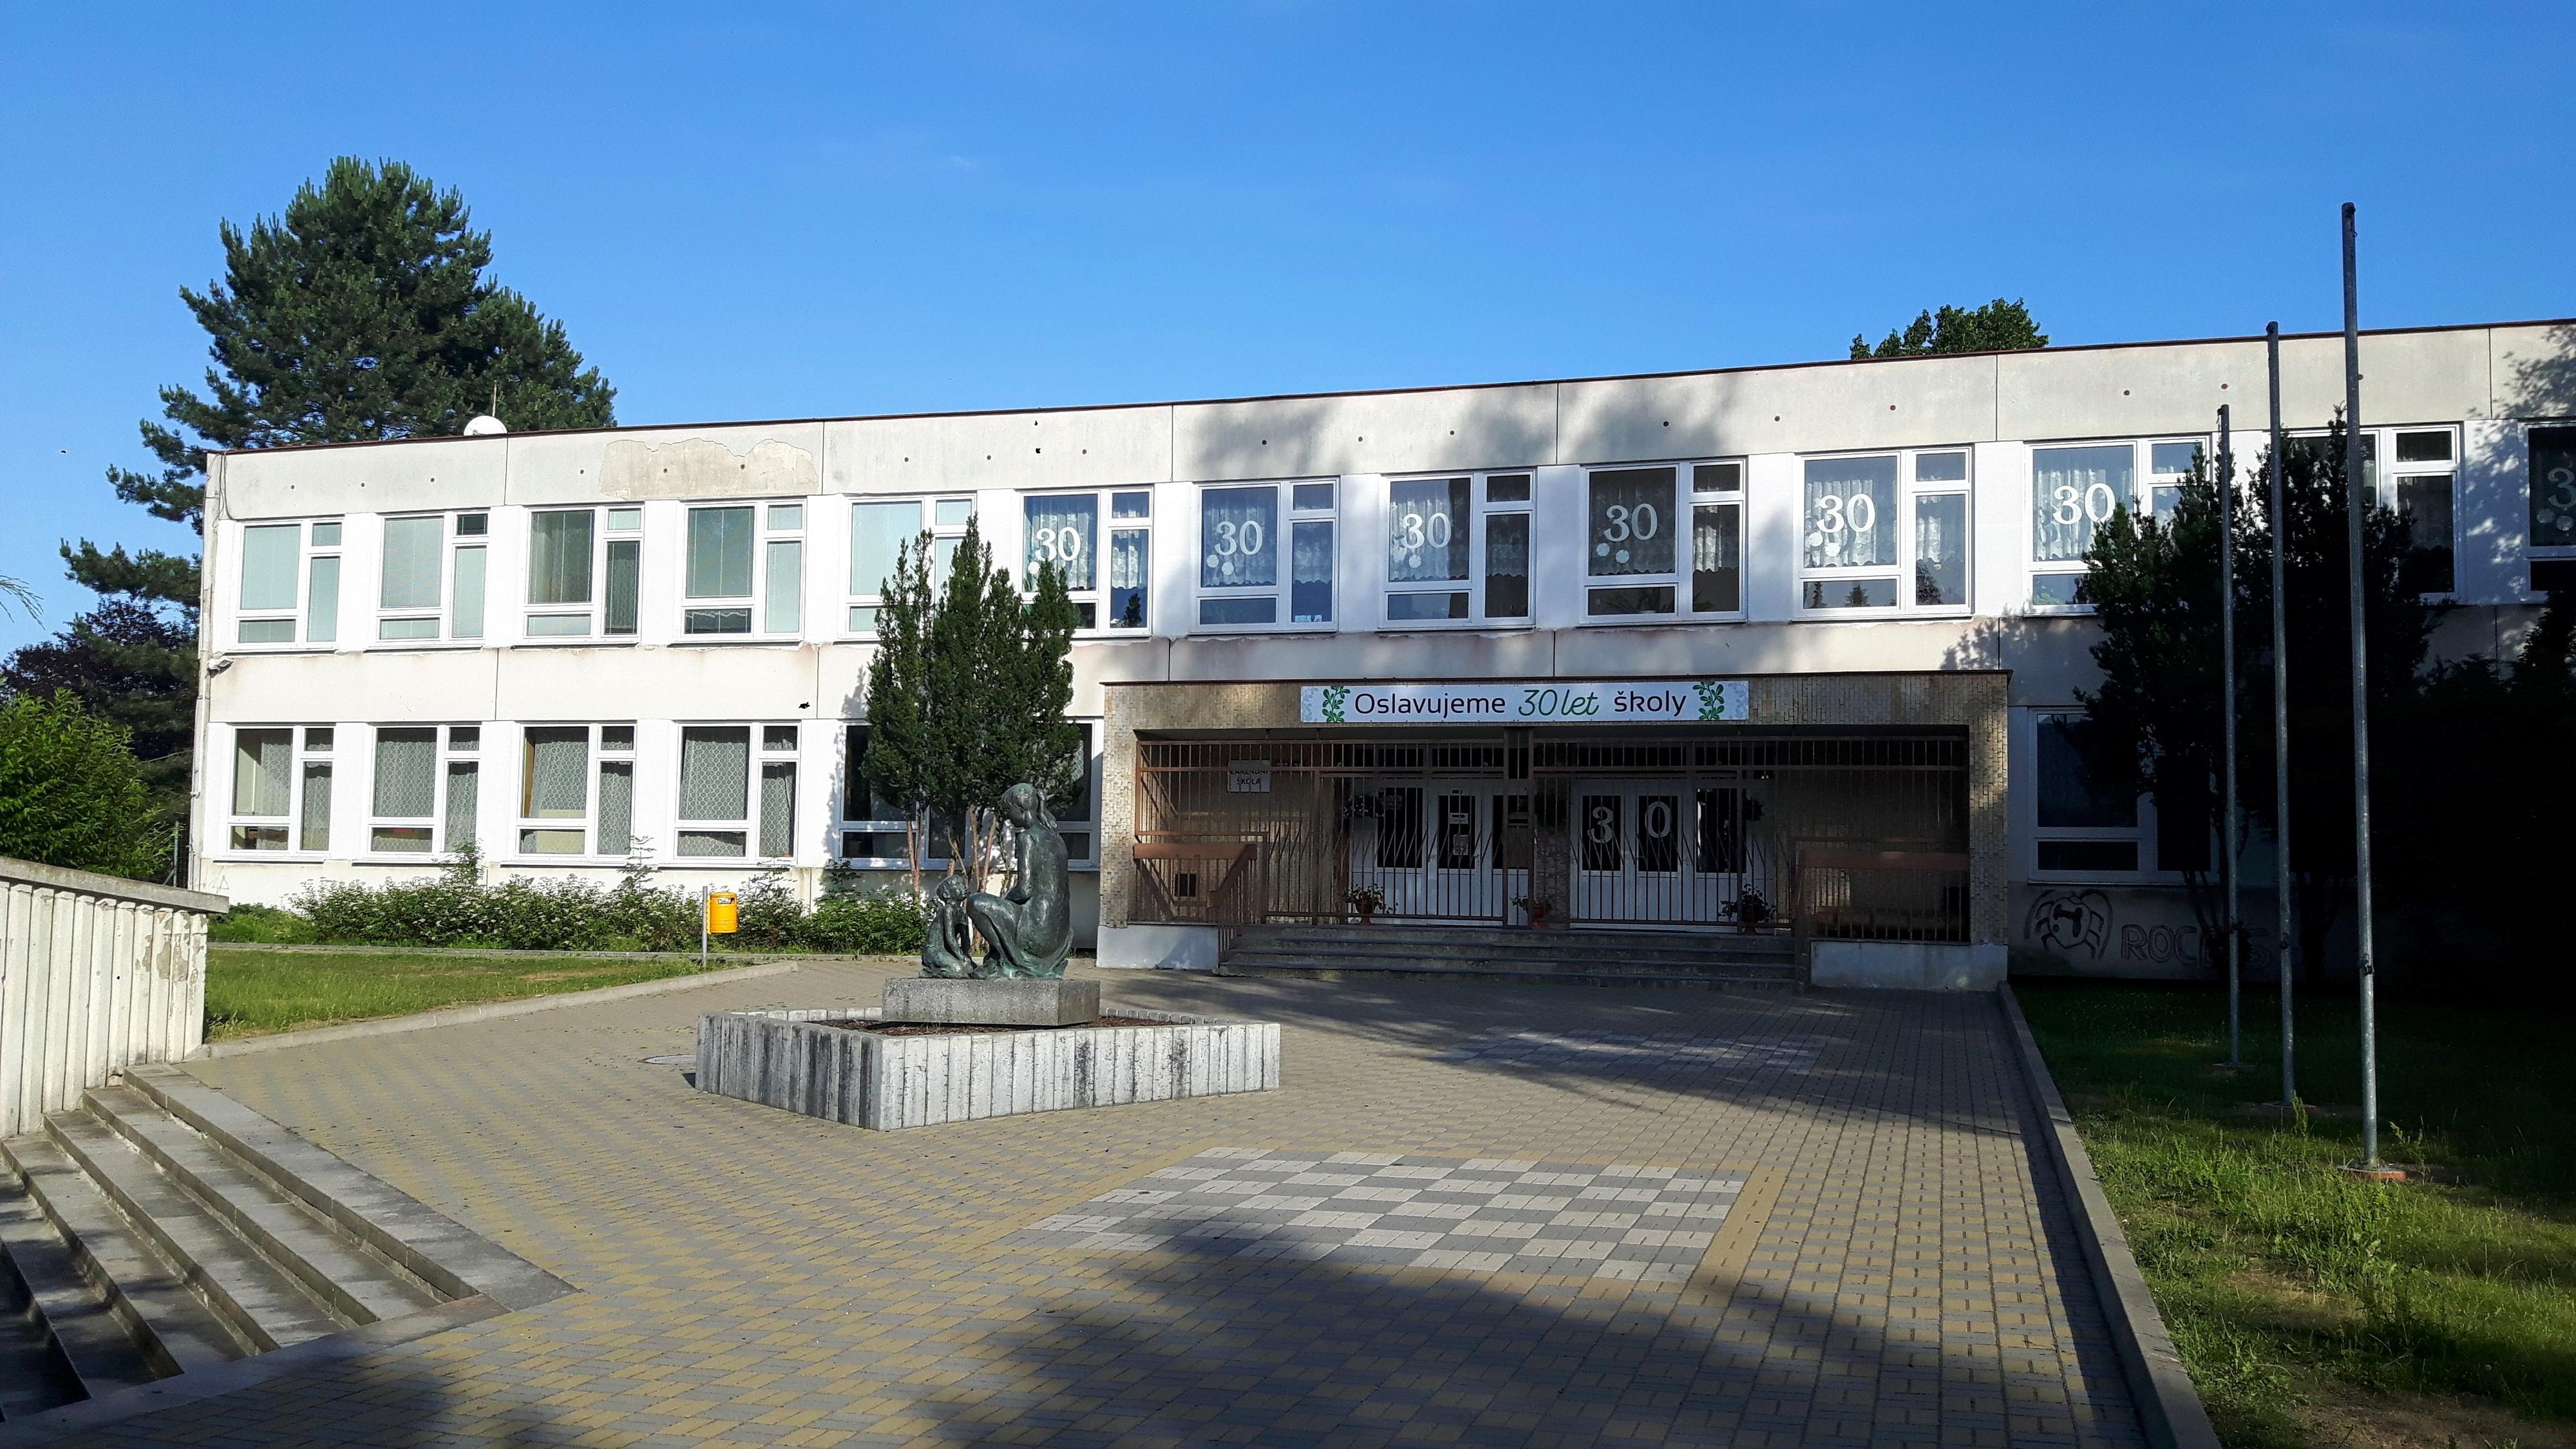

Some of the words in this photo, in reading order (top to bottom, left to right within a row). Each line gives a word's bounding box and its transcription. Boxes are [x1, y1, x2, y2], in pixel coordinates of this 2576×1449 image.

[1816, 493, 1876, 534] 30
[2052, 482, 2116, 525] 30
[1213, 520, 1264, 556] 30
[1400, 513, 1452, 549] 30
[1604, 503, 1658, 542] 30
[1035, 526, 1081, 562] 30
[1354, 692, 1506, 719] Oslavujeme
[1614, 690, 1687, 717] školy
